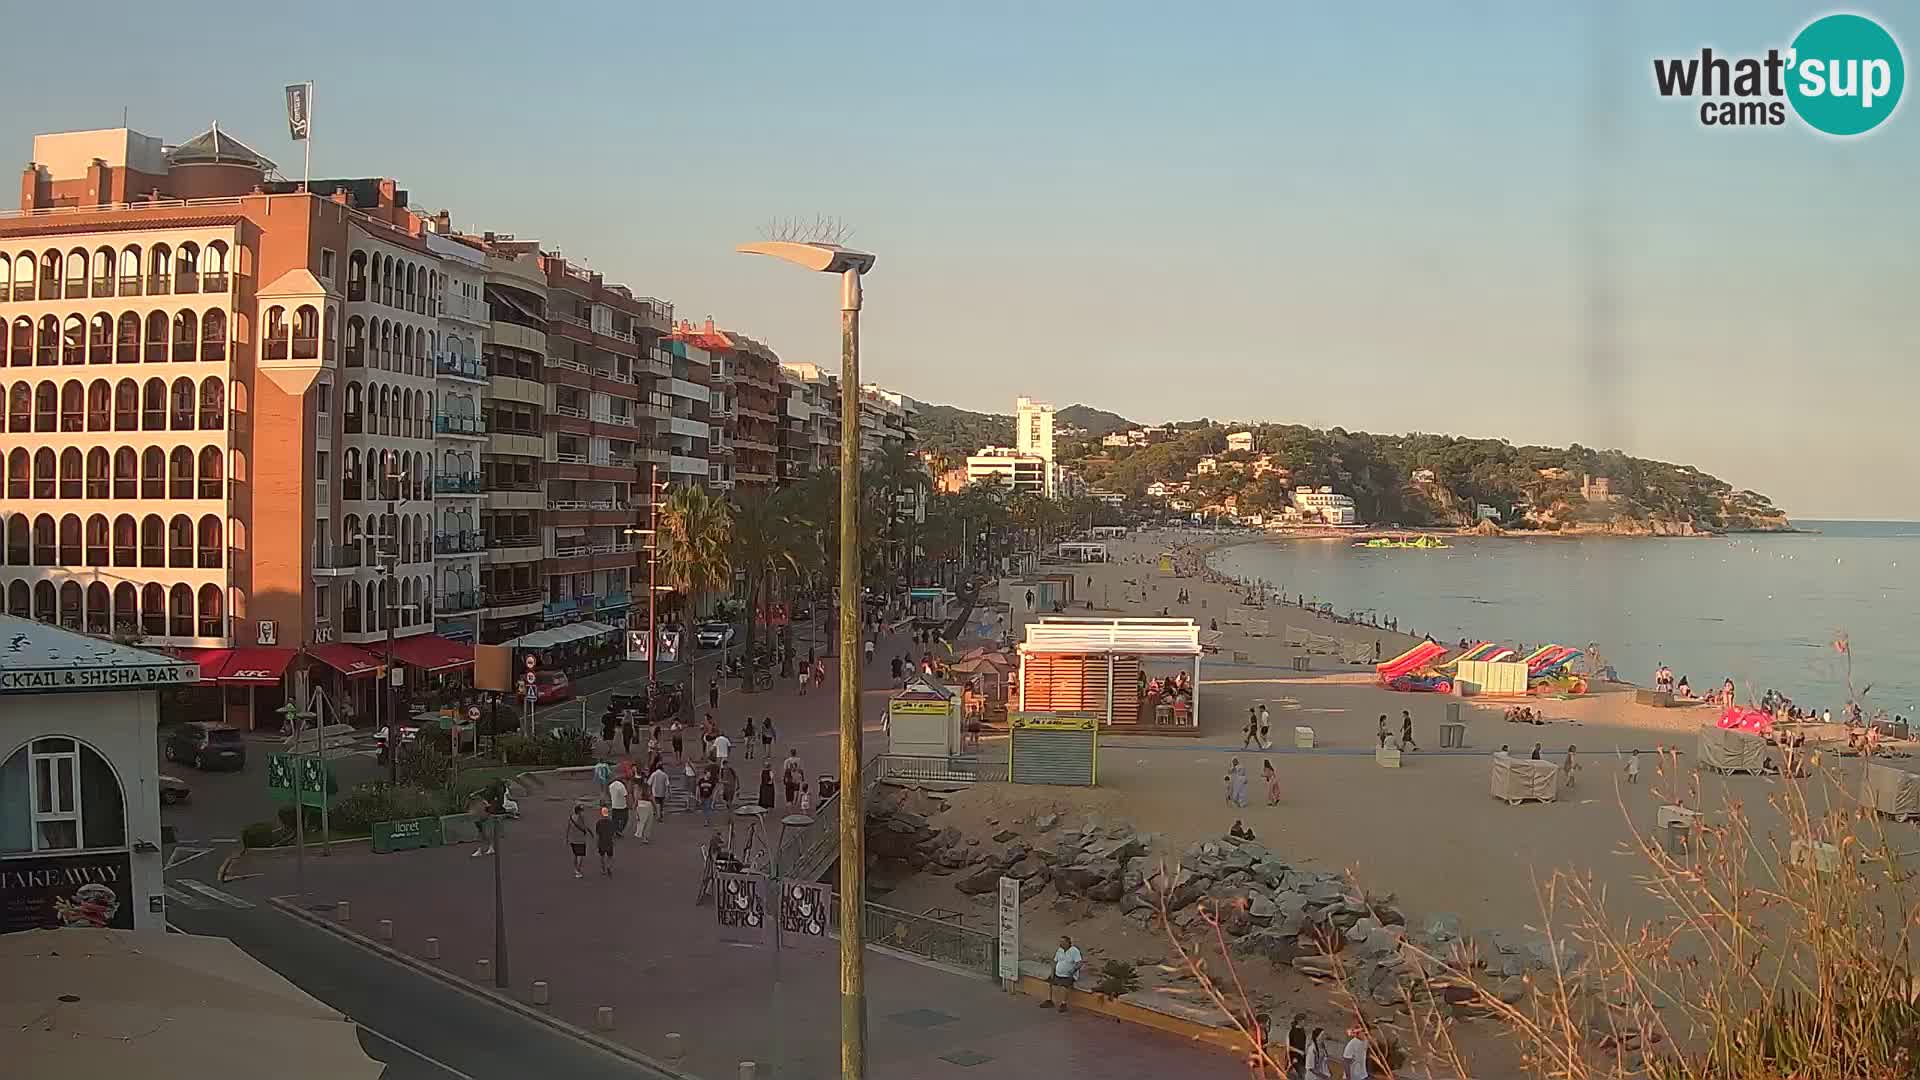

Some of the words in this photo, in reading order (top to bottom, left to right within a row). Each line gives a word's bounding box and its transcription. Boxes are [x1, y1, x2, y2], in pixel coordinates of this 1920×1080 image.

[314, 627, 333, 643] KFC
[64, 671, 76, 686] &
[80, 669, 142, 685] SHISHA
[147, 667, 180, 682] BAR
[233, 669, 271, 677] KFC
